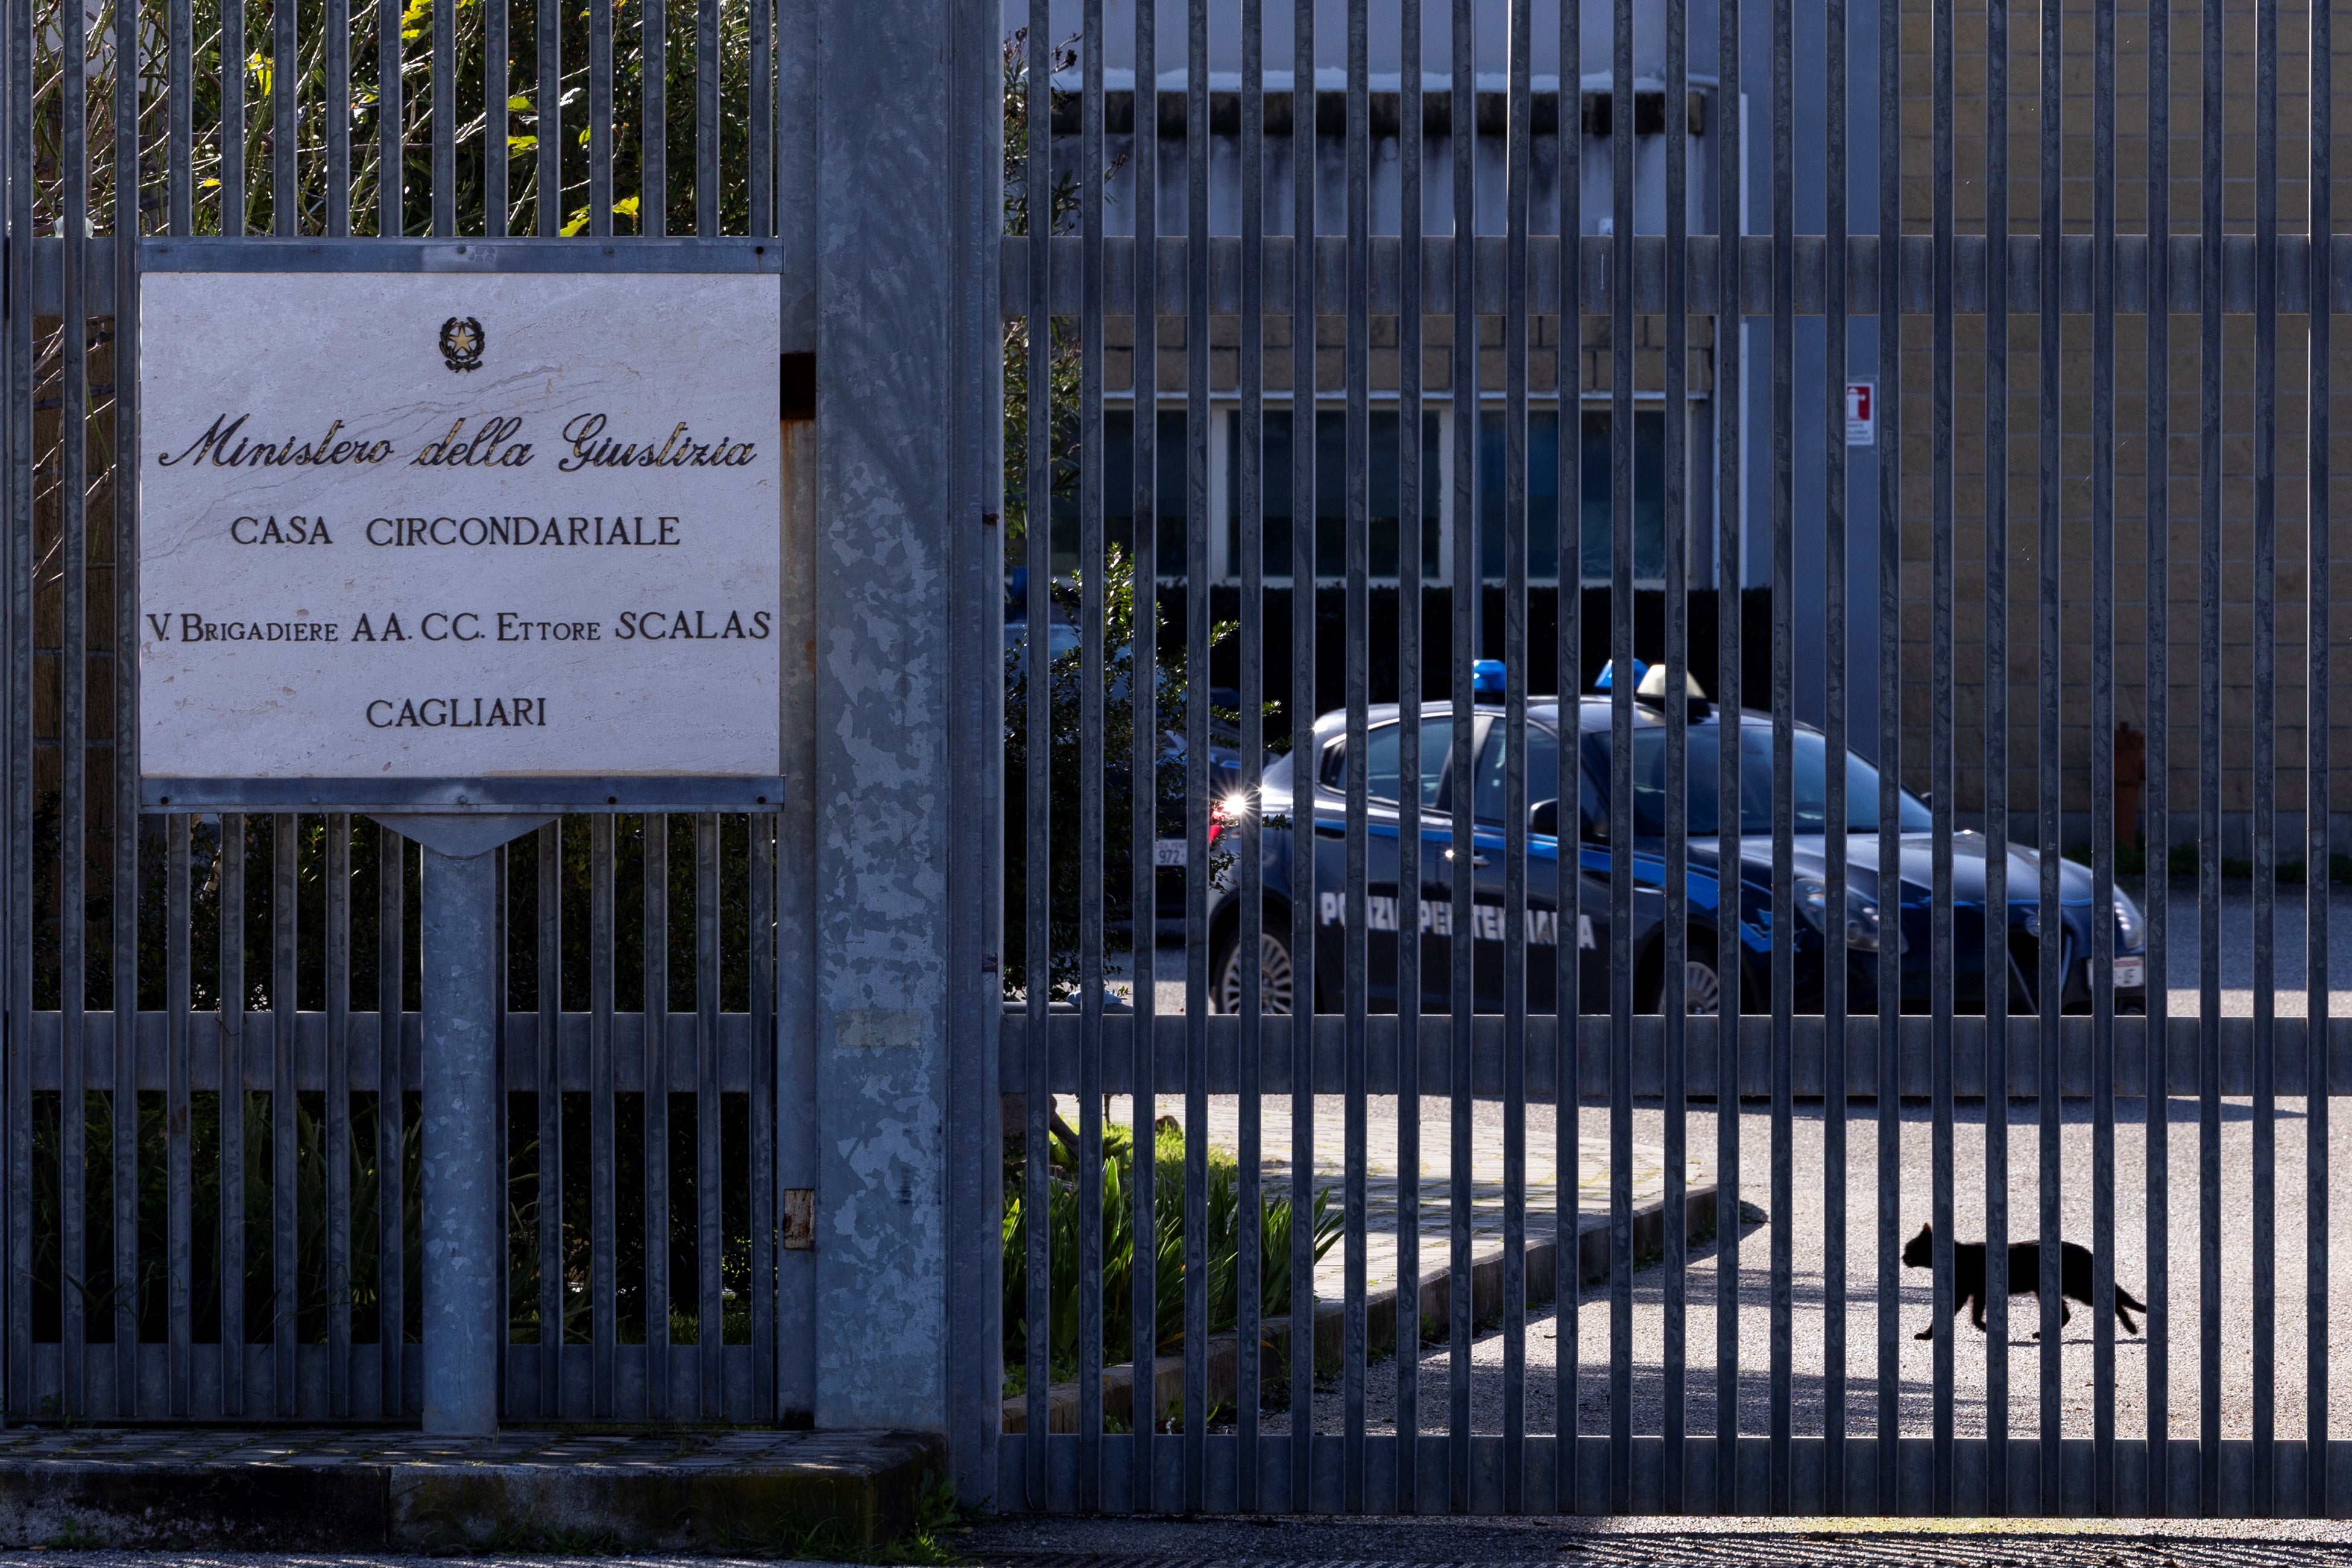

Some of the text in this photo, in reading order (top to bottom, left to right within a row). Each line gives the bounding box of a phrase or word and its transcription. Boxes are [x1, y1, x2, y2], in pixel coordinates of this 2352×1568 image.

[158, 413, 758, 473] Ministero della Giustizia
[231, 515, 681, 547] CASA CIRCONDARIALE
[615, 609, 771, 641] SCALAS
[366, 697, 546, 729] CAGLIARI
